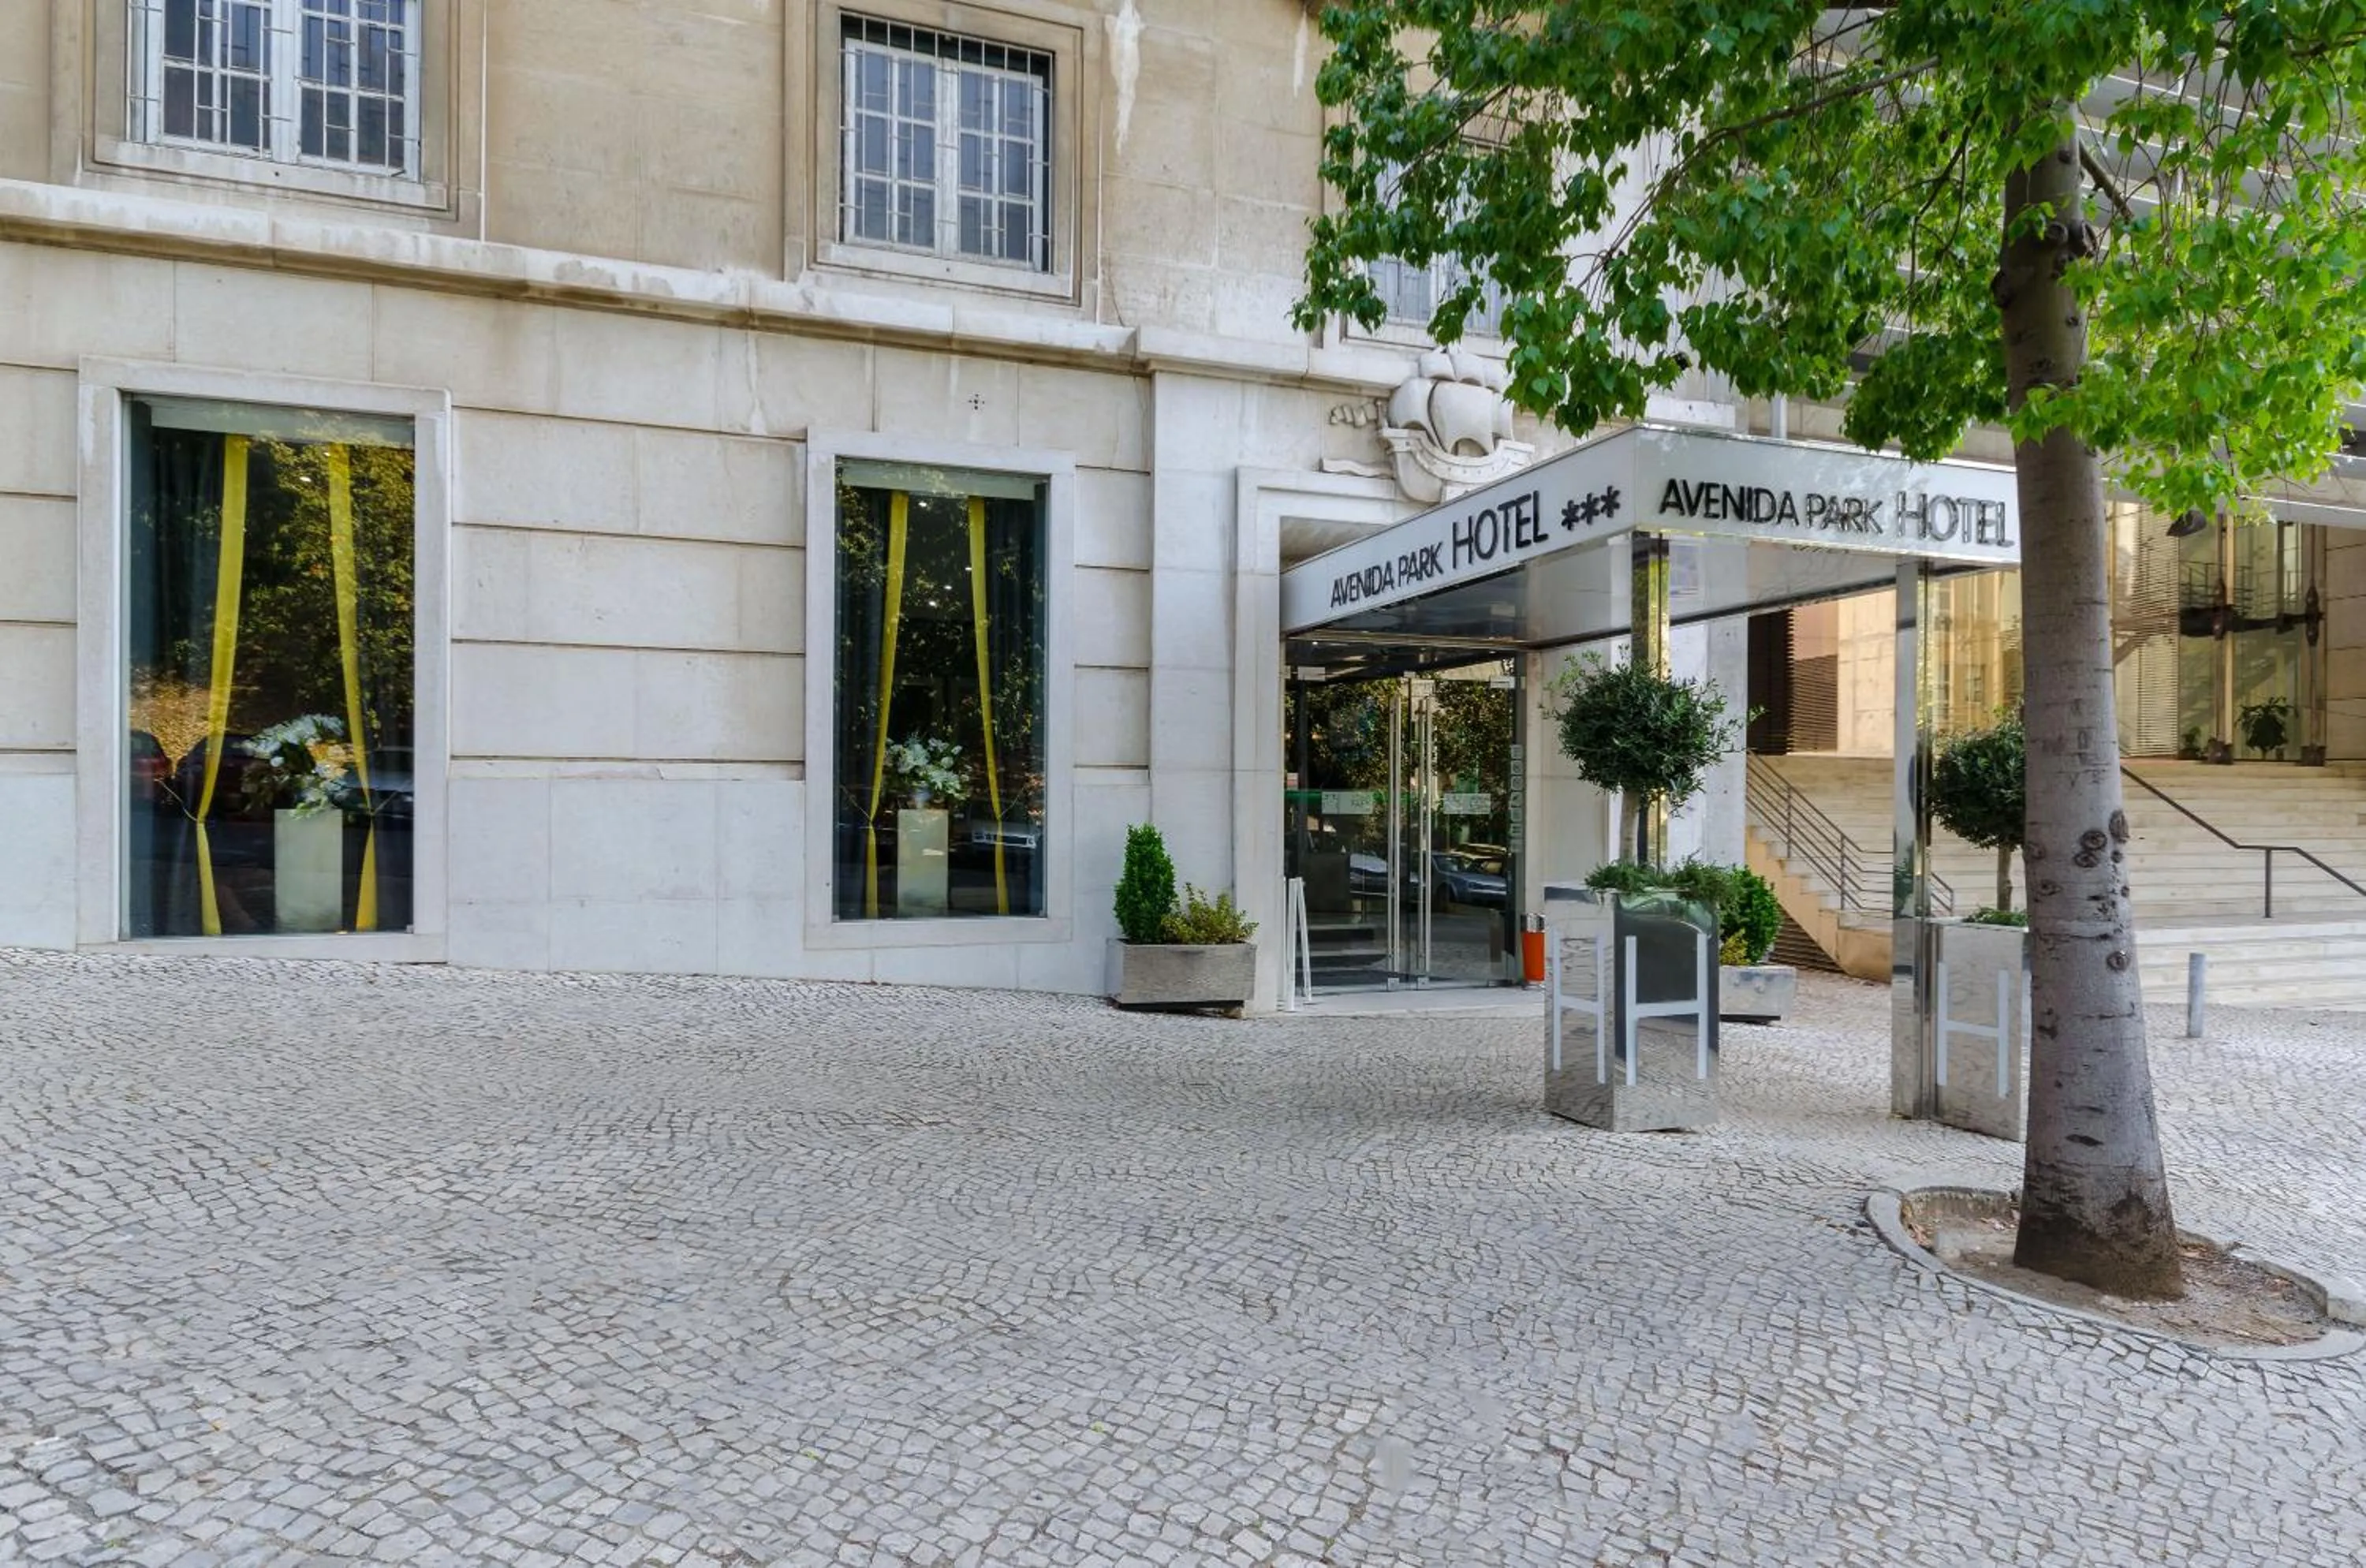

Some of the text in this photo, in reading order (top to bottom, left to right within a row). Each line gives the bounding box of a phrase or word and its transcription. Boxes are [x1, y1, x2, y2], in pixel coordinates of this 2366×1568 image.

[1330, 490, 1550, 608] AVENIDA PARK HOTEL
[1658, 478, 2015, 547] AVENIDA PARK HOTEL
[1552, 926, 1606, 1085] H
[1625, 933, 1709, 1087] H
[1936, 961, 2010, 1099] H
